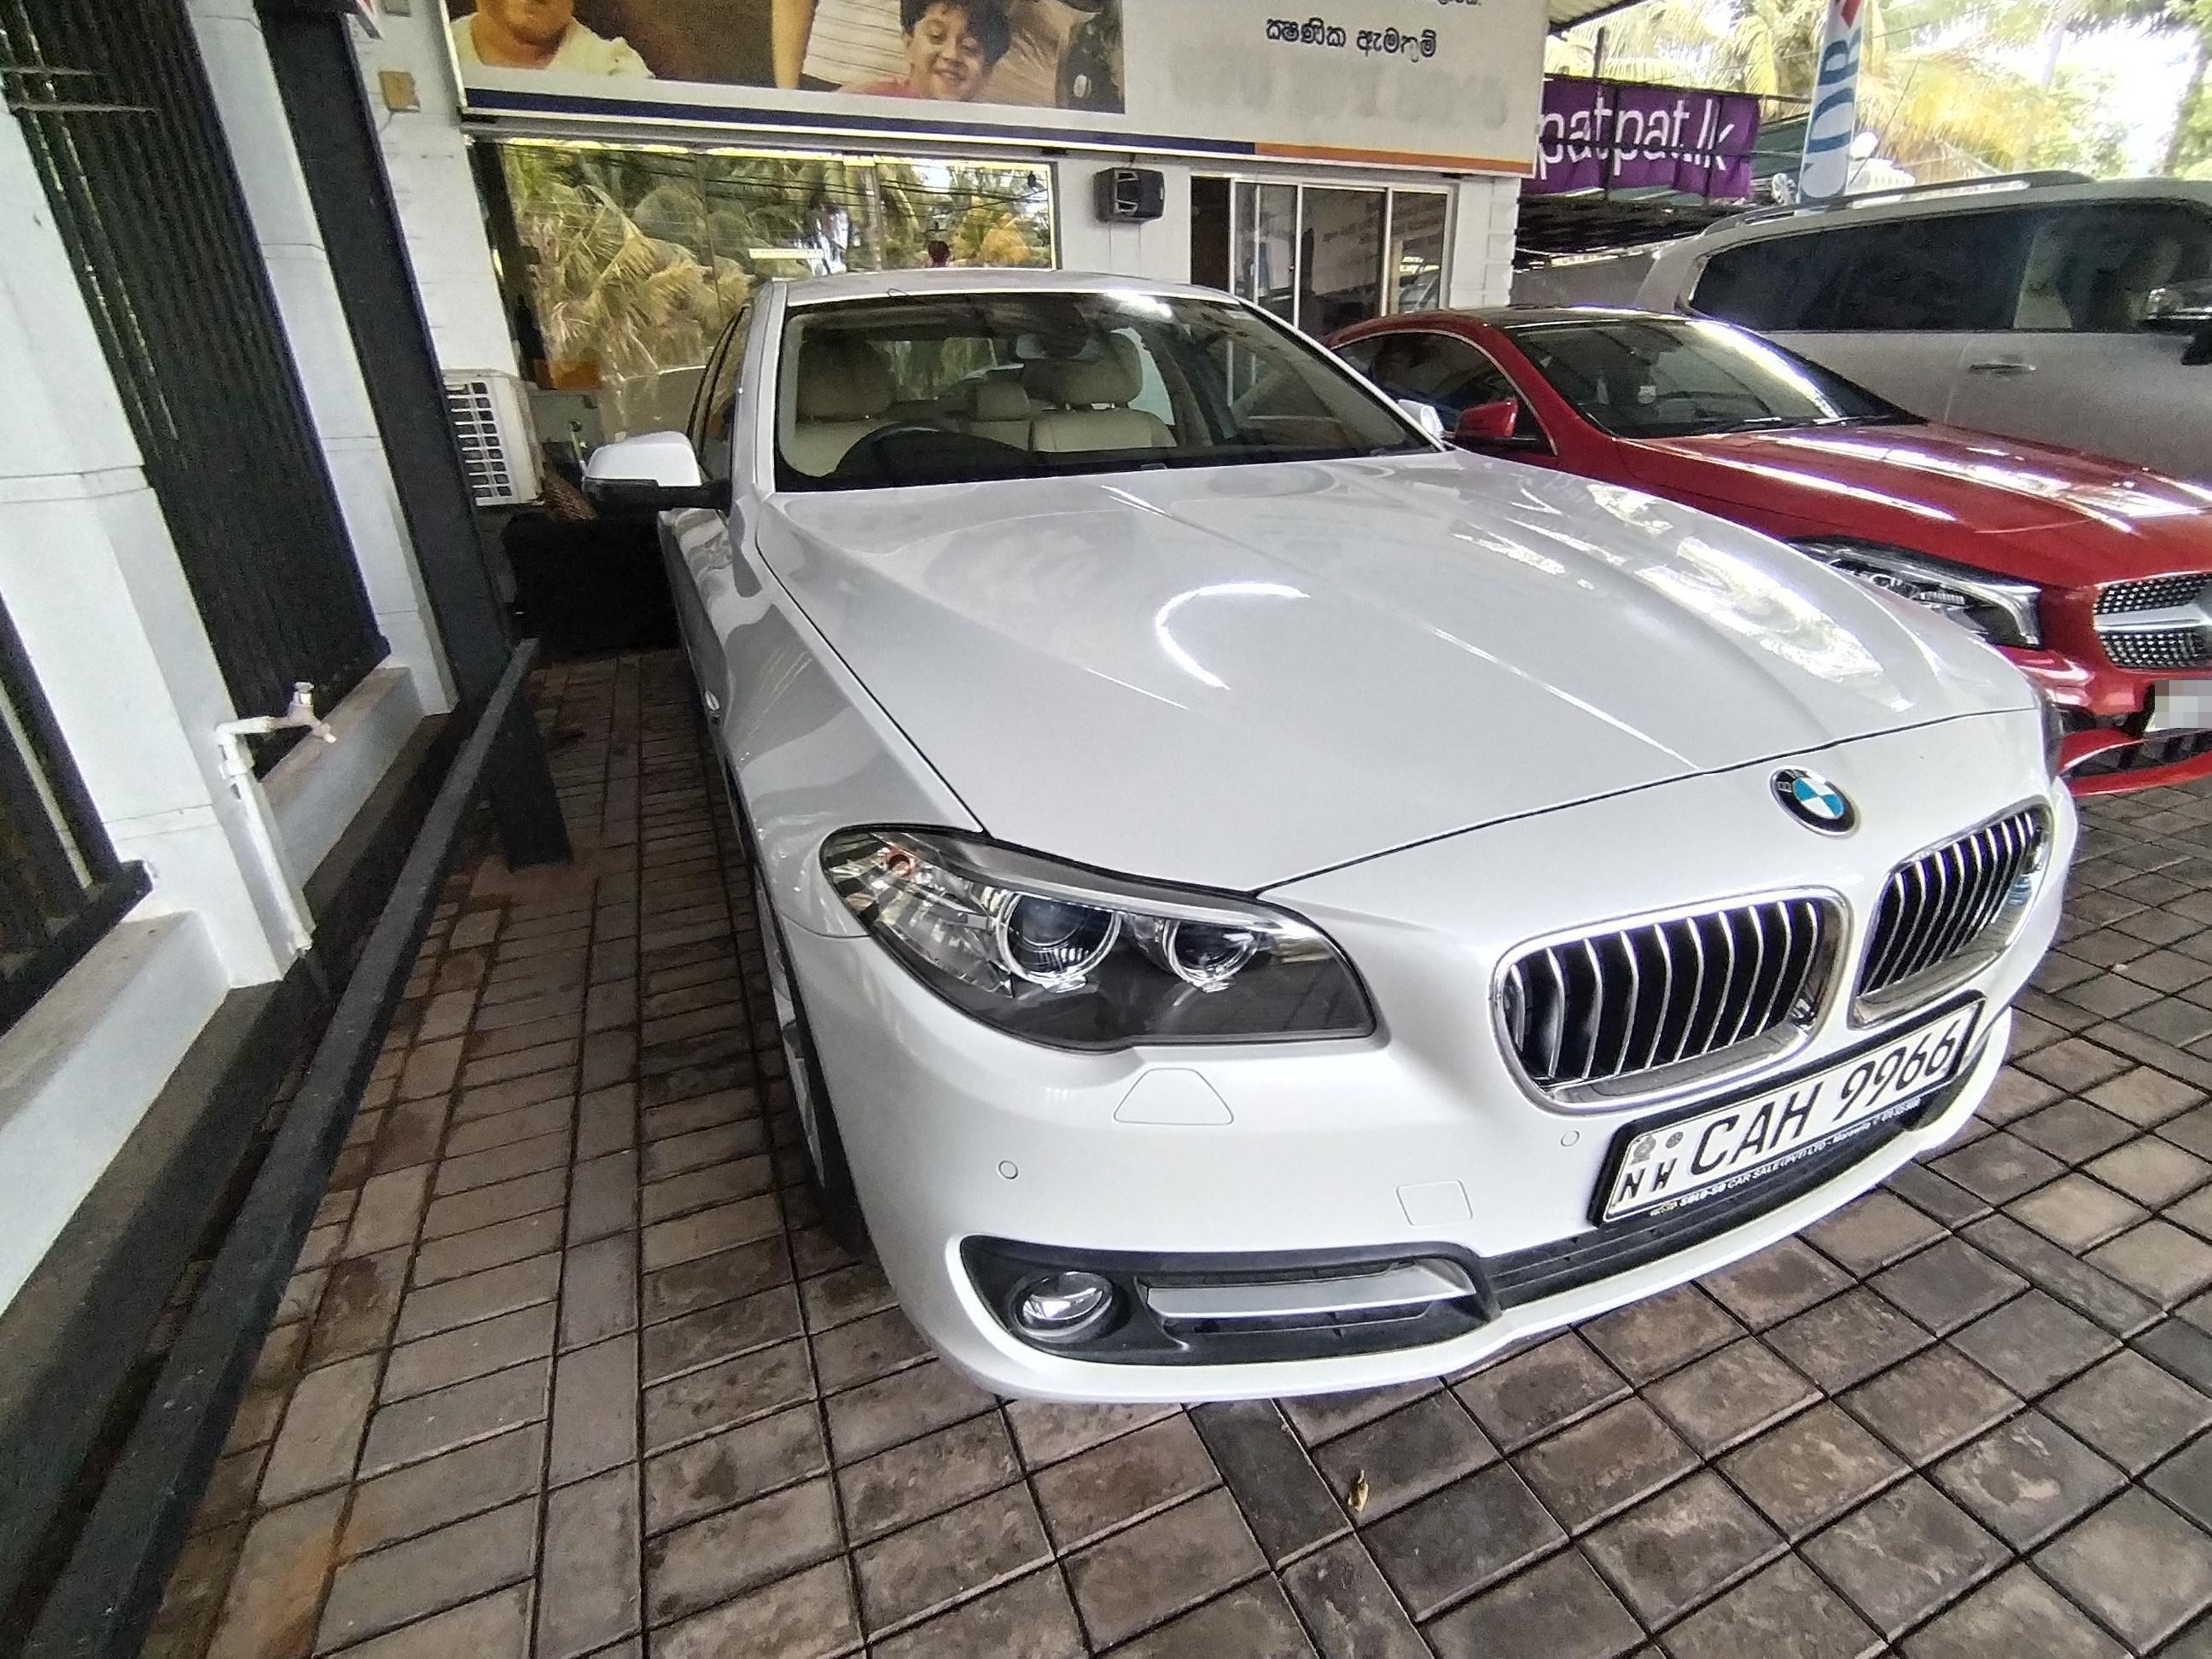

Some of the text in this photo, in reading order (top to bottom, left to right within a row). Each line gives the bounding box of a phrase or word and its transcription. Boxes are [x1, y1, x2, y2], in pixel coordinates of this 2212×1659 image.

[1539, 96, 1734, 179] patpat.lk
[1691, 1083, 1822, 1175] CAH
[1831, 1019, 1960, 1122] 9966
